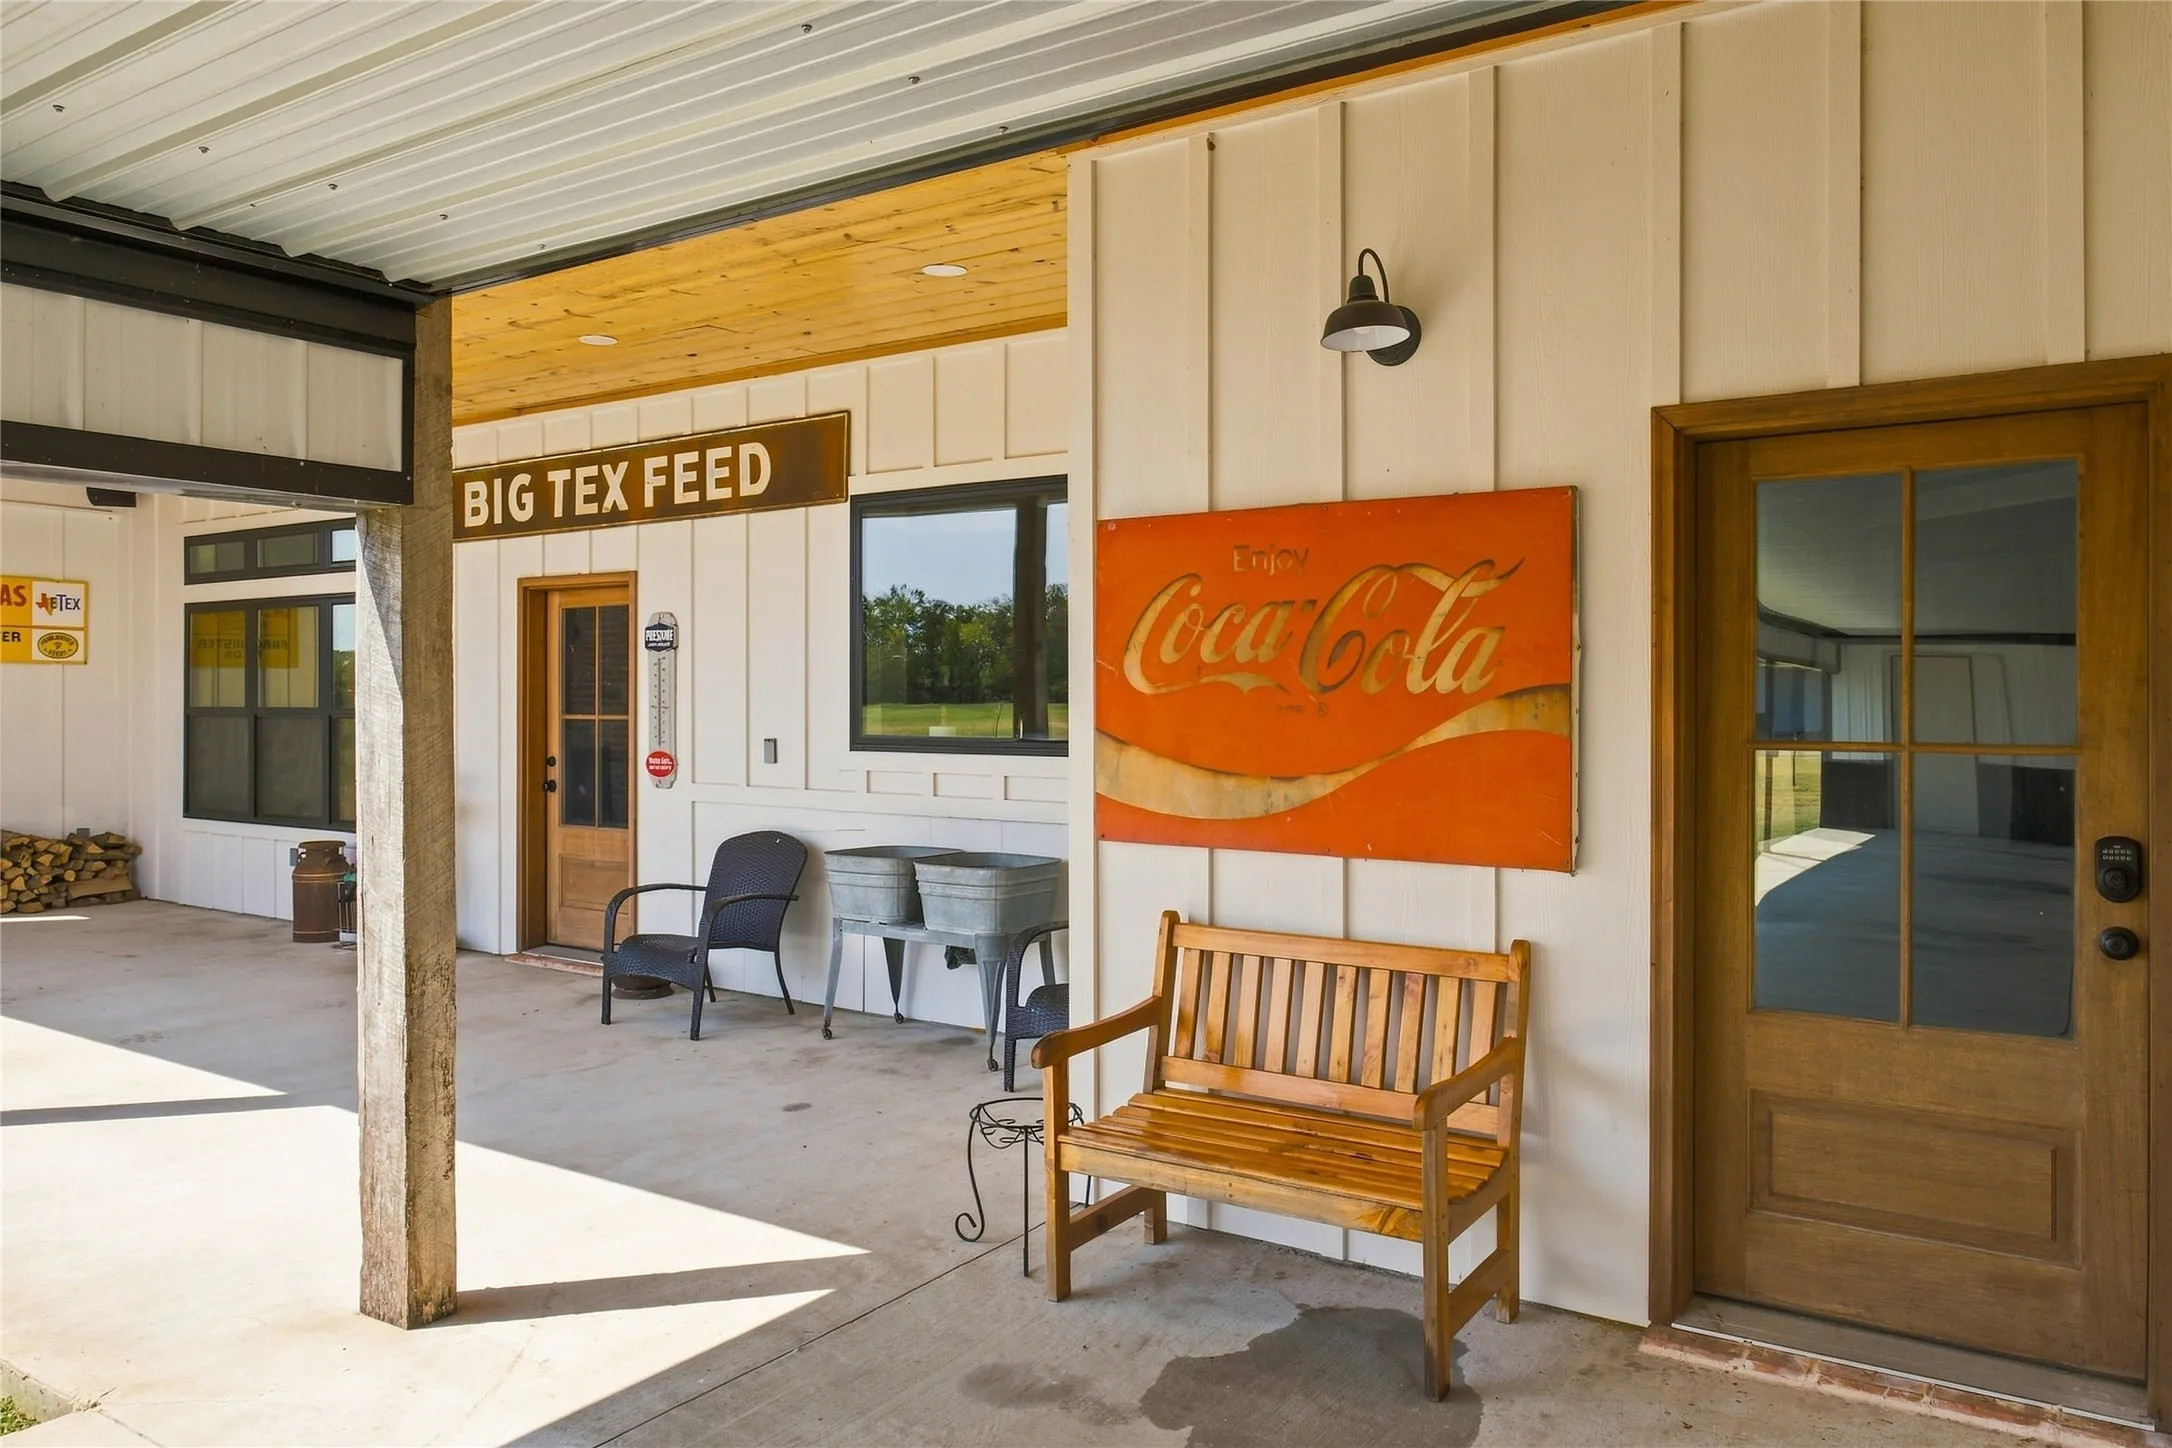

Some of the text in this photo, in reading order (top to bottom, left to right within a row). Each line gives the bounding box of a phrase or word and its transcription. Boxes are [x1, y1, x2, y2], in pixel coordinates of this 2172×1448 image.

[464, 442, 772, 527] BIG TEX FEED
[1233, 544, 1309, 577] Enjoy
[0, 631, 21, 642] ER
[1123, 557, 1527, 695] Coca-Cola
